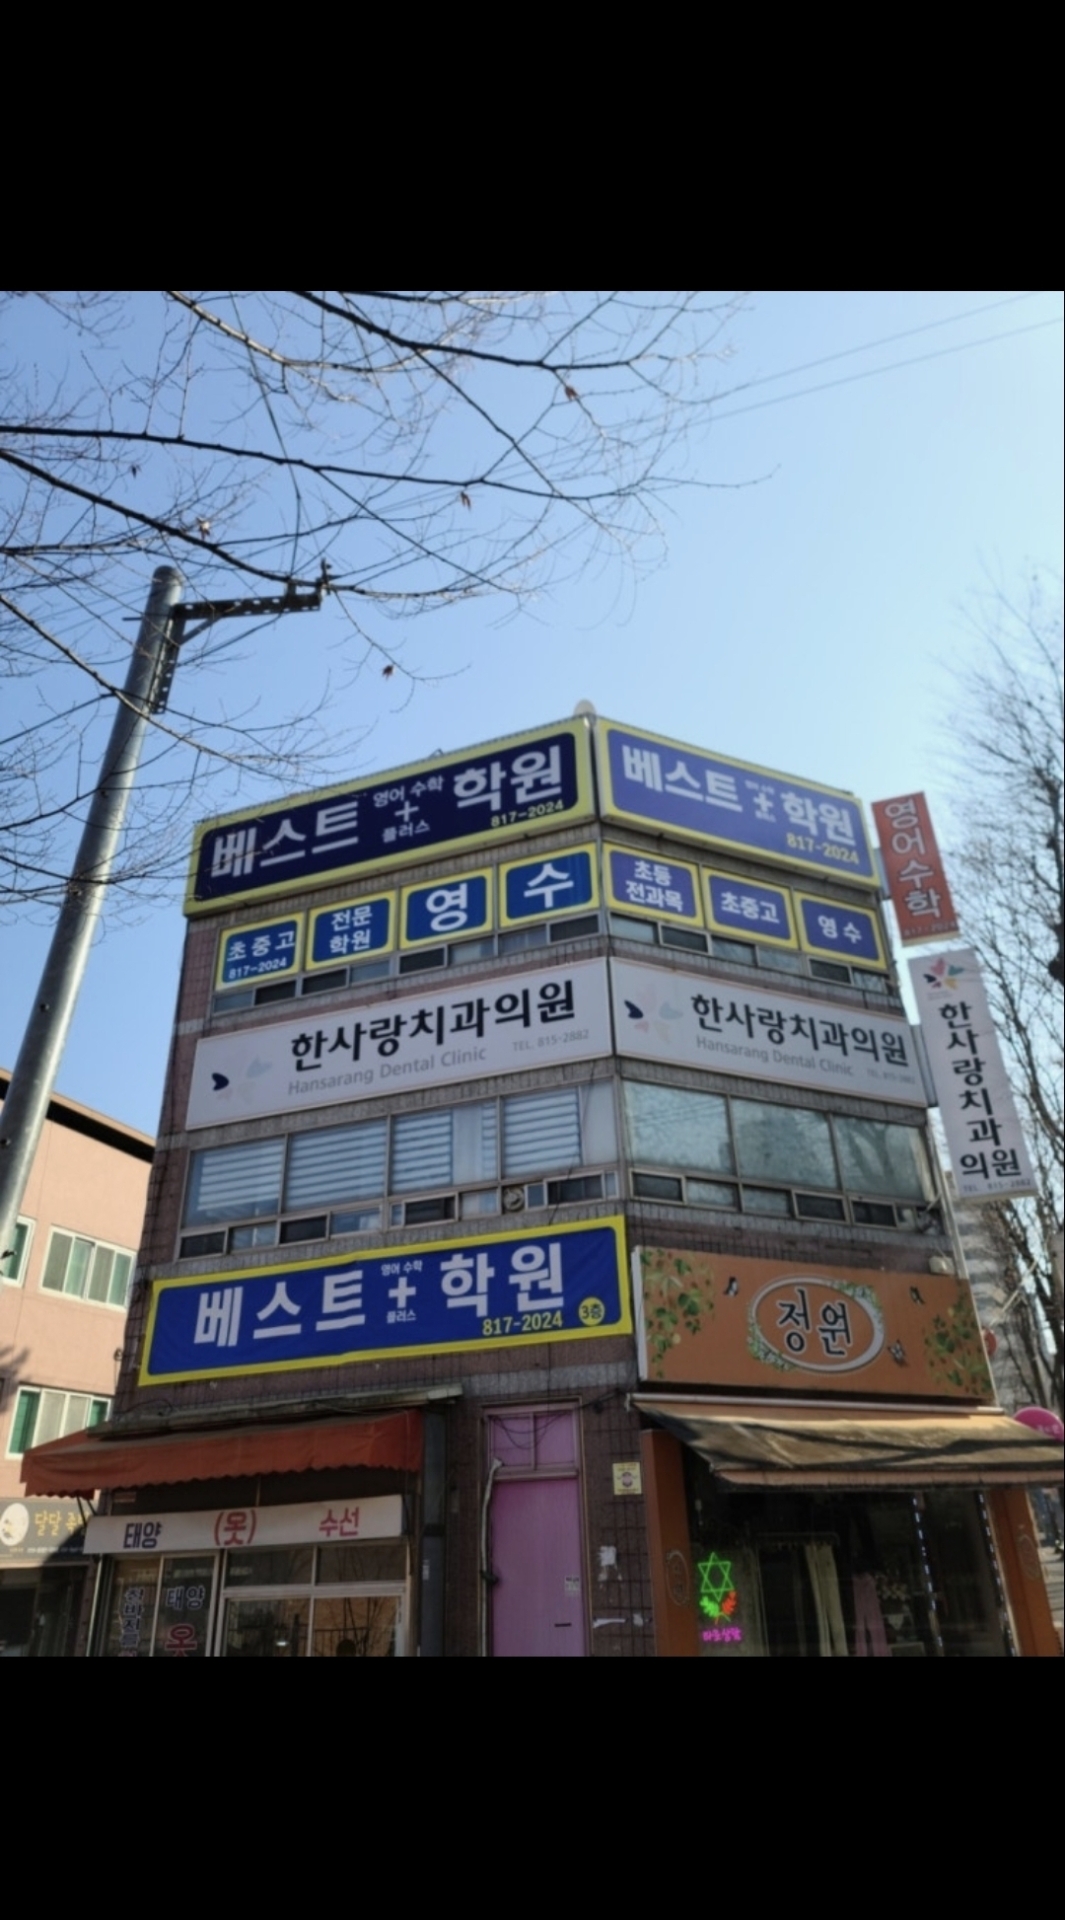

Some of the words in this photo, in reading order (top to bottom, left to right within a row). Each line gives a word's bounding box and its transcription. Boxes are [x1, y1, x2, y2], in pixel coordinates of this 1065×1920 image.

[373, 784, 405, 808] 영어
[410, 775, 444, 797] 수학
[622, 745, 742, 813] 베스트
[781, 792, 856, 847] 학원
[210, 800, 359, 878] 베스트
[453, 745, 563, 811] 학원
[491, 799, 564, 827] 817-2024
[786, 832, 860, 865] 817-2024
[524, 863, 574, 909] 수
[634, 860, 671, 887] 초등
[426, 883, 468, 932] 영
[626, 881, 684, 911] 전과목
[721, 891, 780, 924] 초중고
[331, 905, 373, 931] 전문
[329, 928, 371, 954] 학원
[228, 957, 287, 979] 817-2024
[291, 980, 576, 1072] 한사랑치과의원
[537, 1029, 590, 1049] 815-2882
[690, 993, 909, 1067] 한사랑치과의원
[288, 1066, 374, 1096] Hansarang
[380, 1054, 435, 1079] Dental
[441, 1046, 487, 1068] Clinic
[695, 1036, 769, 1064] Hansarang
[772, 1049, 816, 1071] Dental
[820, 1057, 854, 1077] Clinic
[194, 1269, 366, 1347] 베스트
[440, 1242, 564, 1318] 학원
[482, 1310, 563, 1337] 817-2024
[776, 1287, 851, 1356] 정원
[123, 1521, 162, 1550] 태양
[213, 1507, 257, 1546] (옷)
[319, 1507, 361, 1538] 수선
[166, 1584, 206, 1612] 태양
